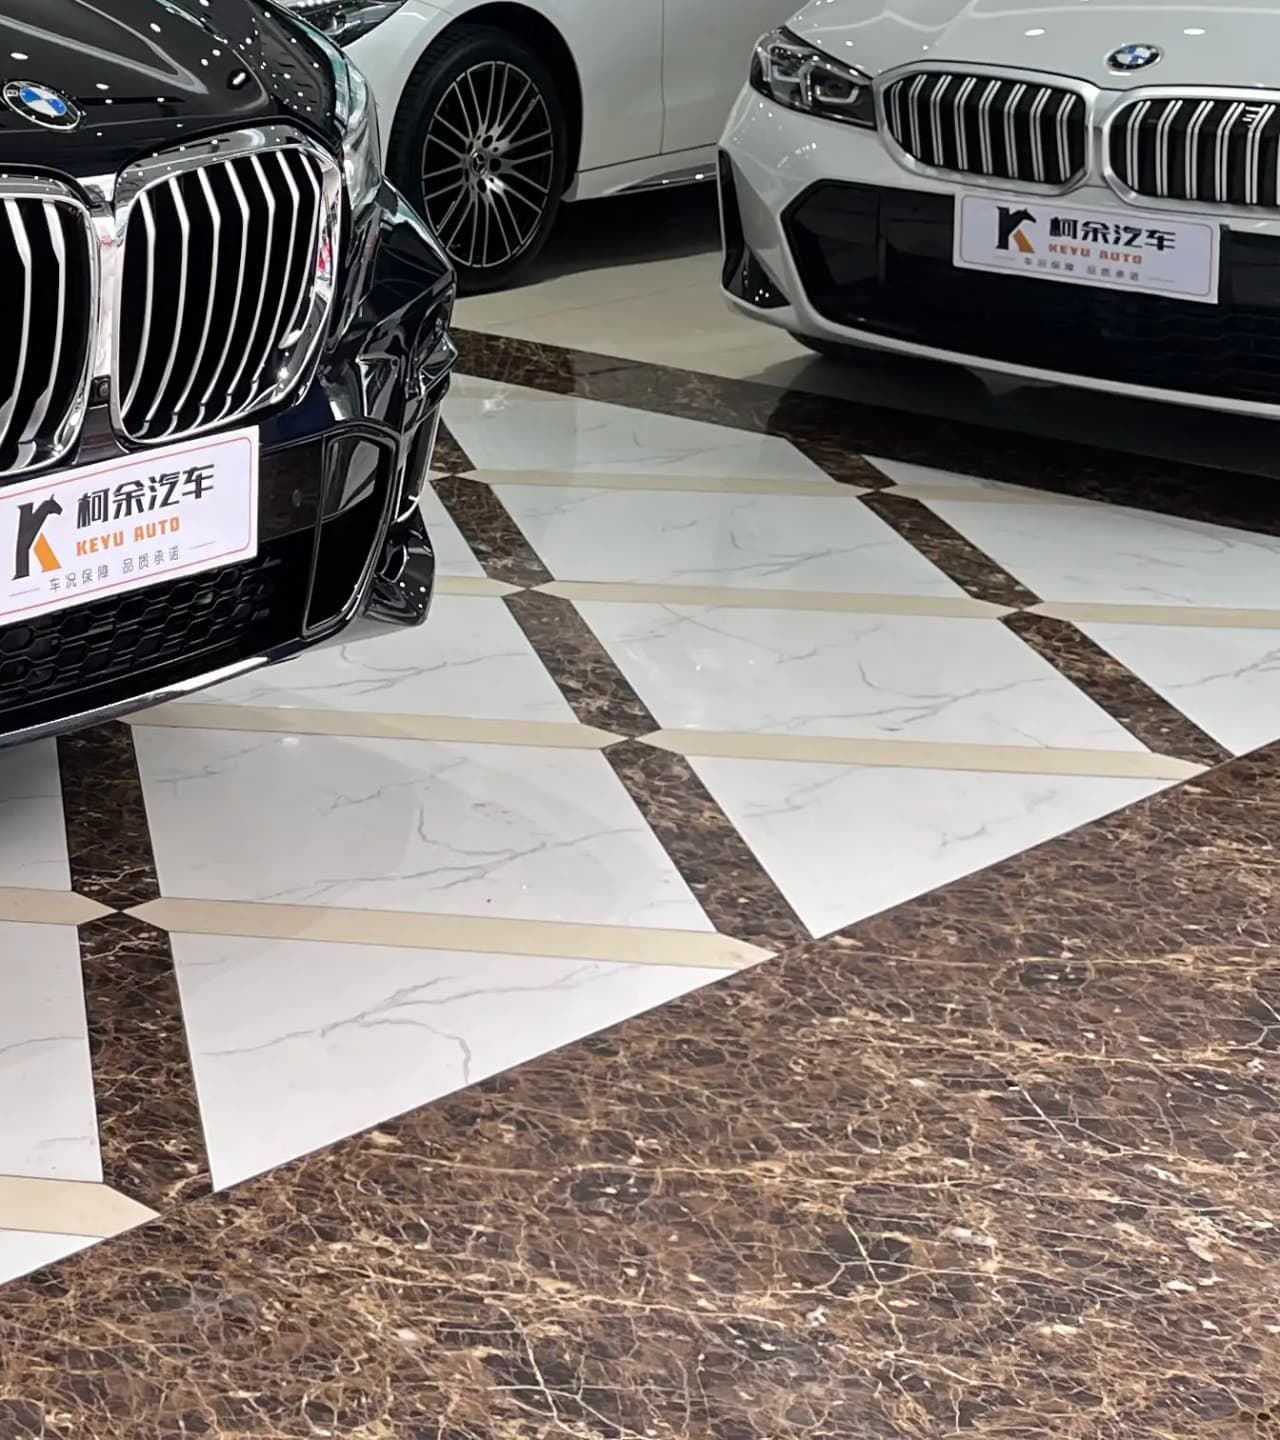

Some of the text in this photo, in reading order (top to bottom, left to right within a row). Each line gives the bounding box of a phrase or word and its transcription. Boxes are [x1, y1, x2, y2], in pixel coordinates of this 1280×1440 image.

[1049, 216, 1176, 251] 柯余汽车
[1048, 243, 1143, 265] KEYU AUTO
[76, 464, 215, 529] 柯余汽车
[76, 517, 181, 557] KEYU AUTO
[48, 545, 180, 593] 车况保障 品质承诺
